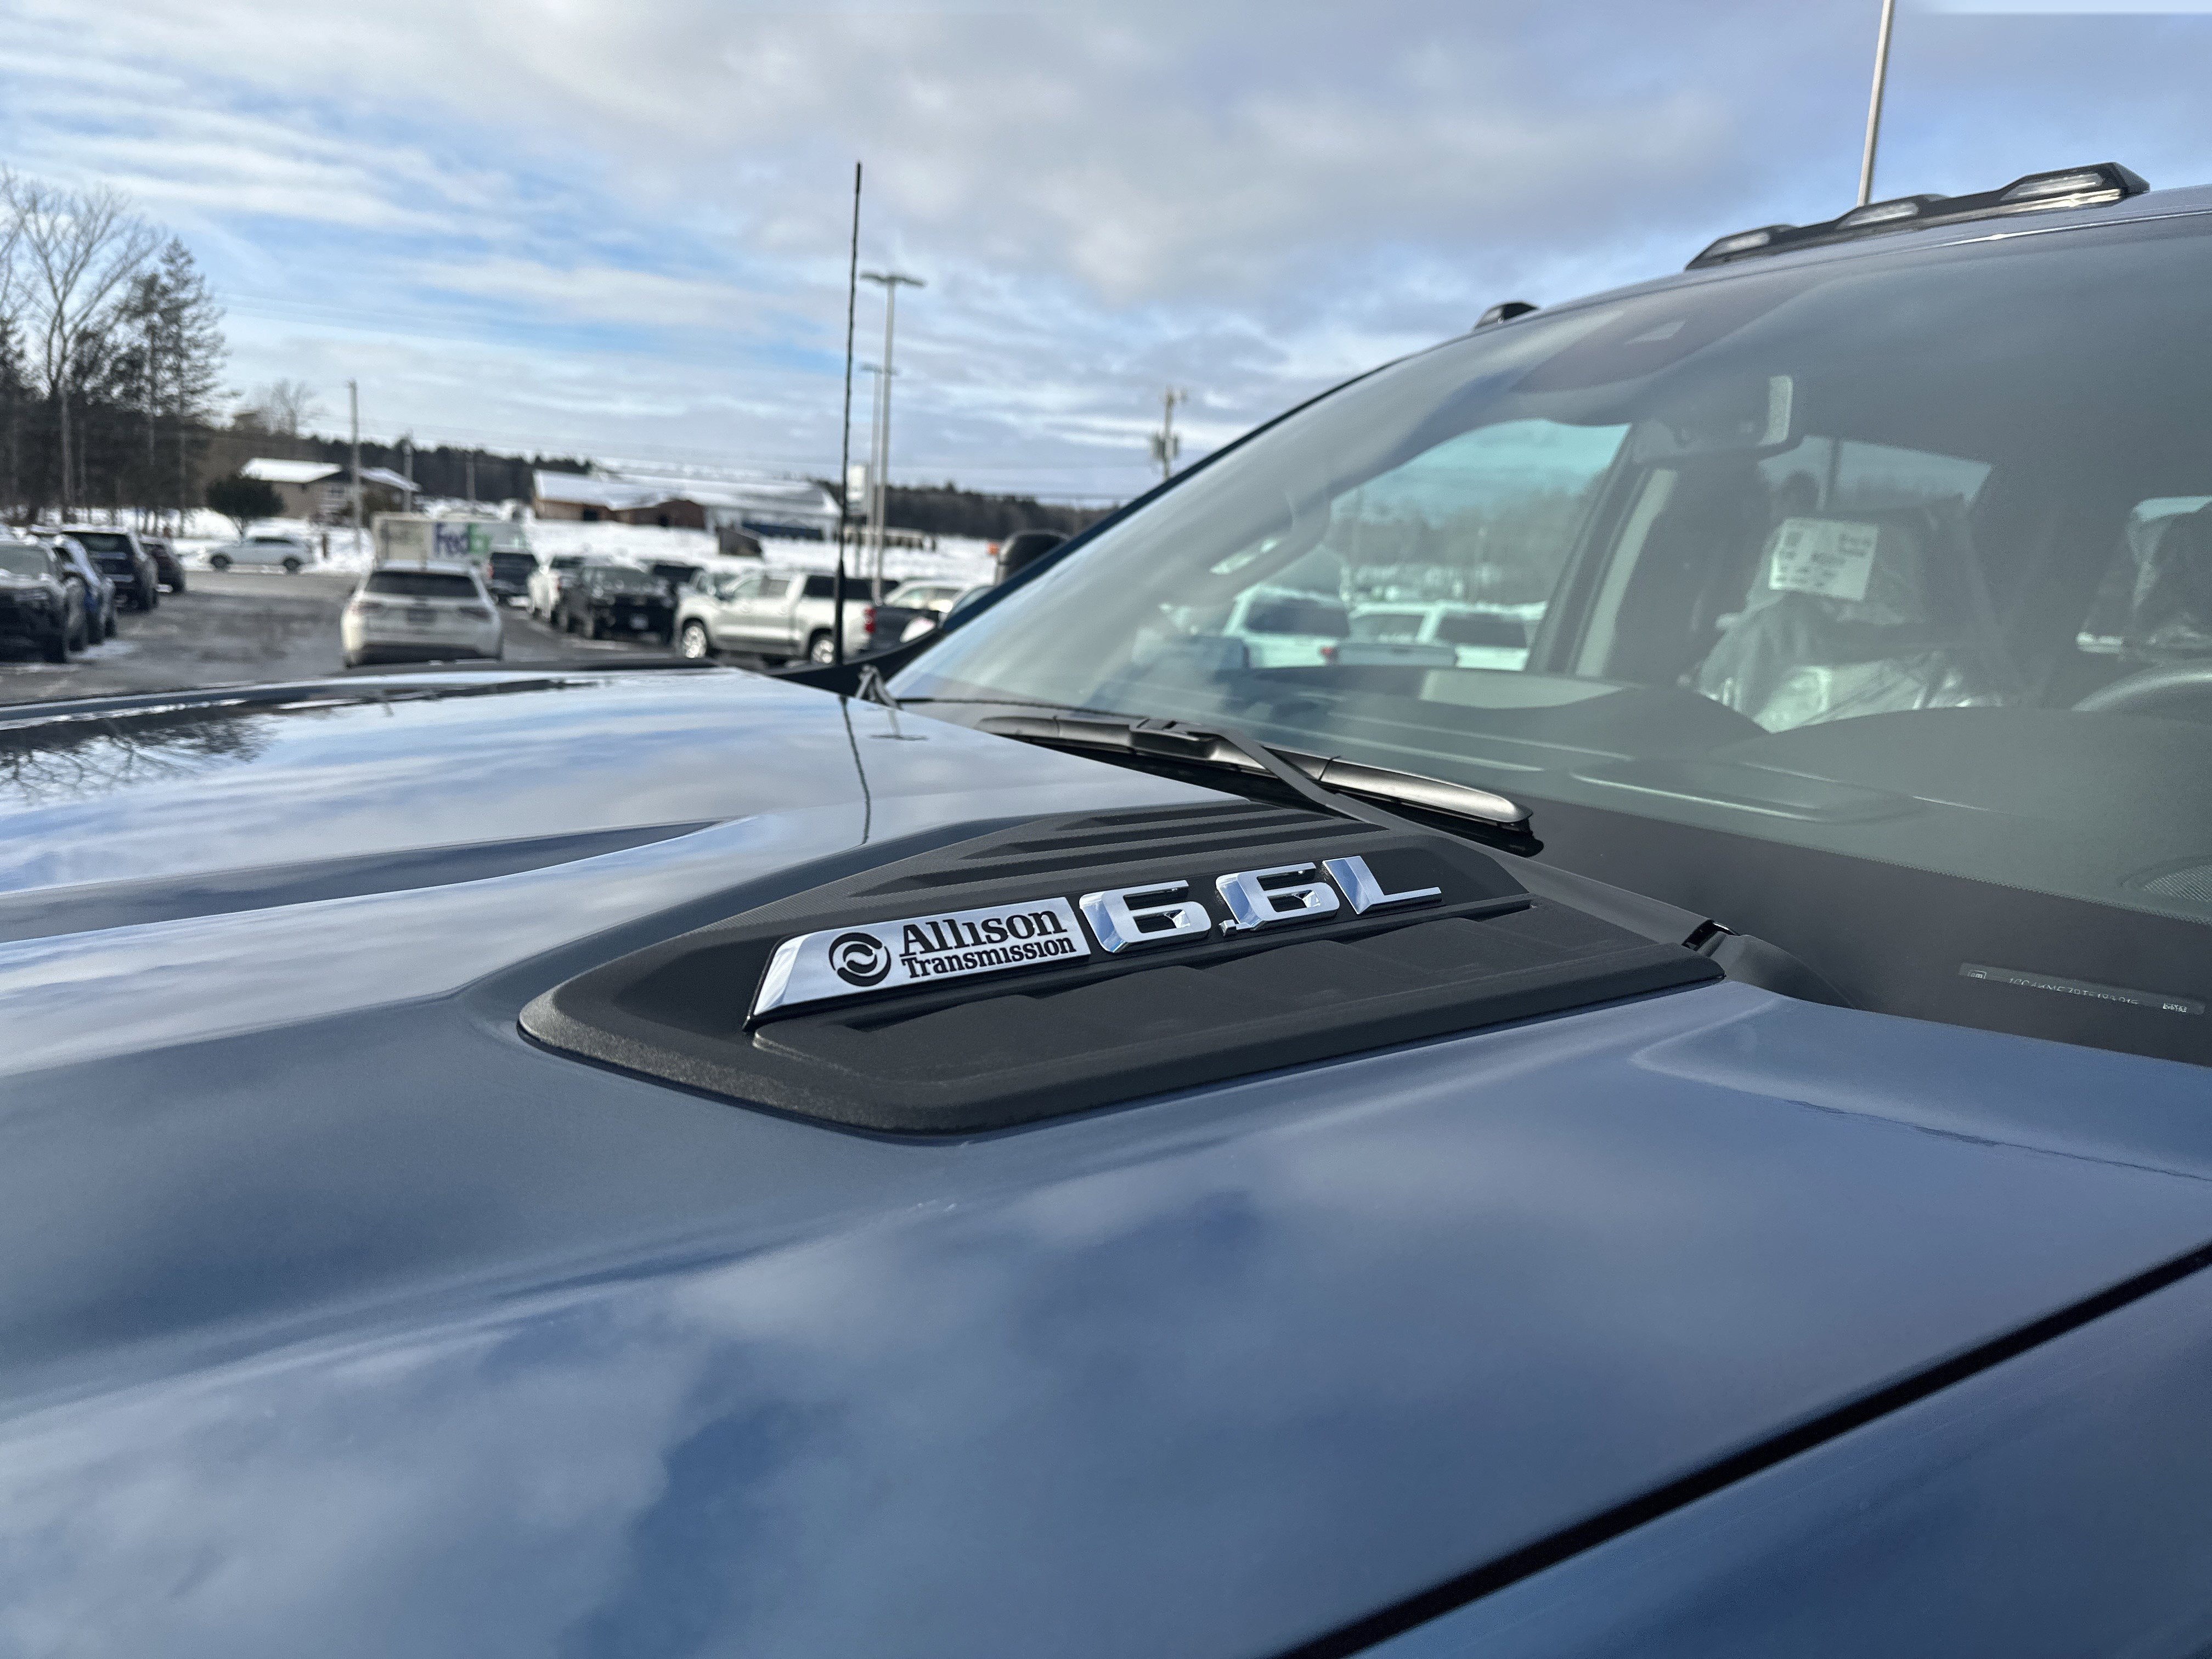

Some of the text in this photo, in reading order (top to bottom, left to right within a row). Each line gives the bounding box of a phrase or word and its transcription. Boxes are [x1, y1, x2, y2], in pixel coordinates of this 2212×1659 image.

[1079, 855, 1442, 954] 6.6L
[900, 910, 1068, 958] Allison
[901, 936, 1077, 979] Transmission
